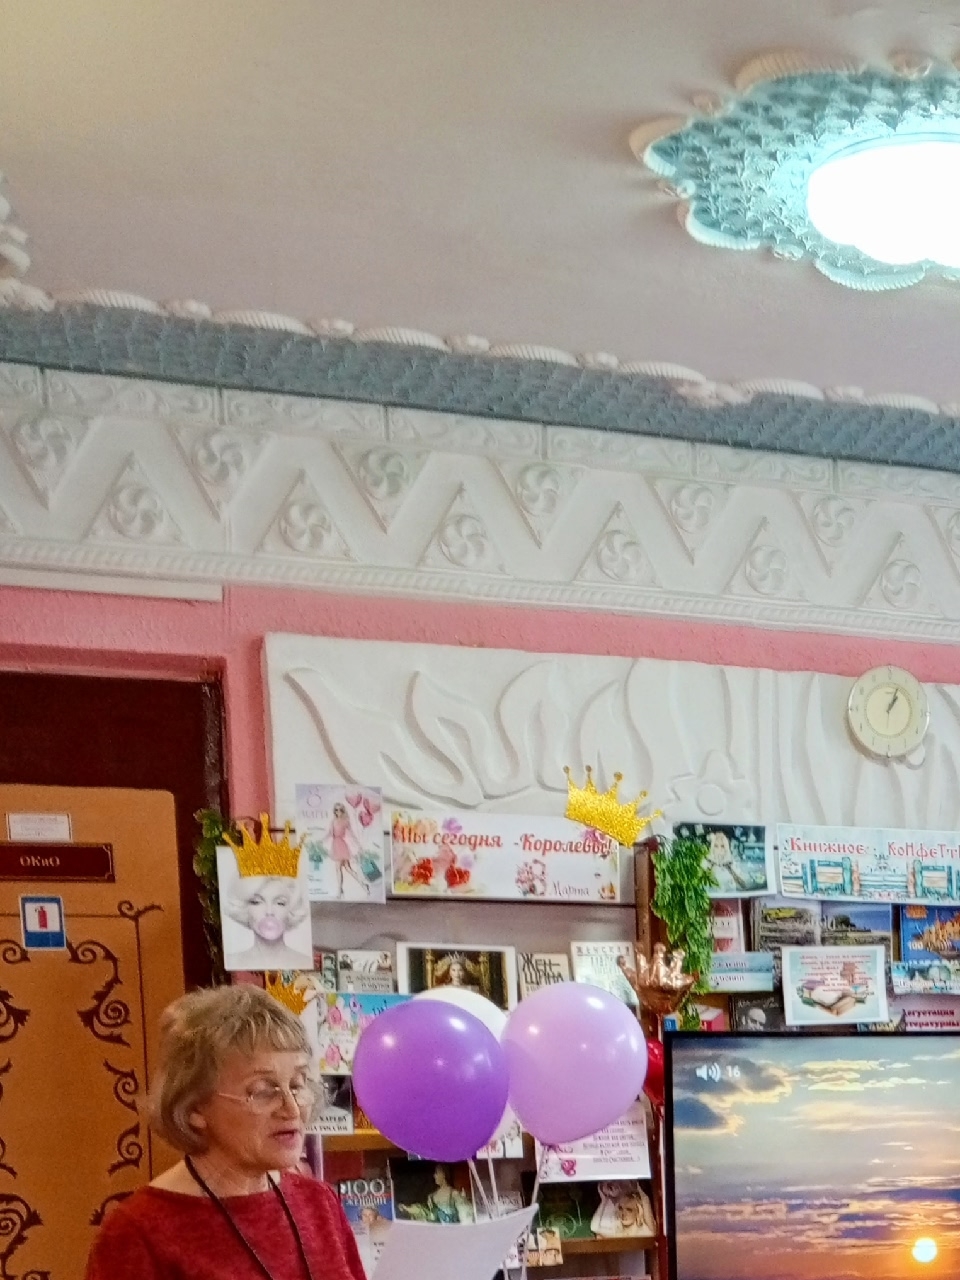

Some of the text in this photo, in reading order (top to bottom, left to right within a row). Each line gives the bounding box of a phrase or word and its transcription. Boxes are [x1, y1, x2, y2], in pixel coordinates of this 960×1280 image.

[432, 831, 503, 851] сегодня
[789, 837, 865, 855] Книжное
[551, 880, 591, 897] Марта
[904, 1009, 955, 1018] егустация
[726, 1065, 741, 1077] 16
